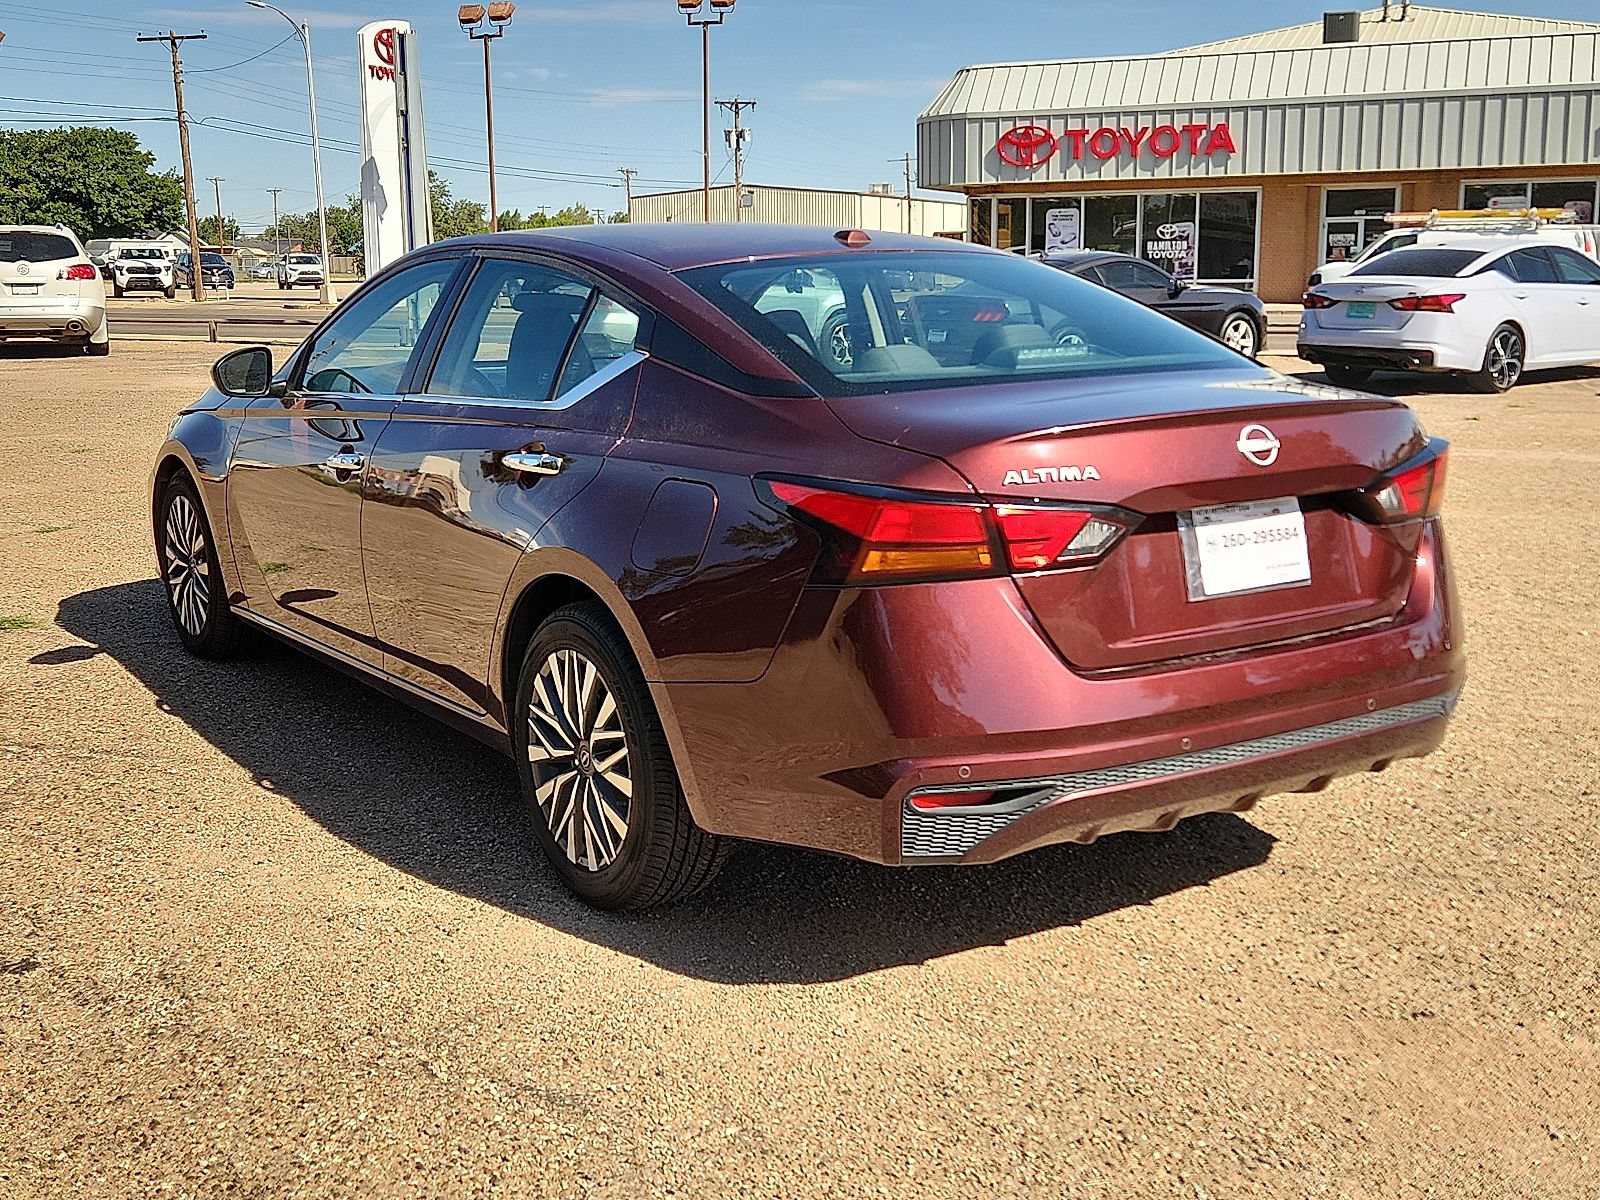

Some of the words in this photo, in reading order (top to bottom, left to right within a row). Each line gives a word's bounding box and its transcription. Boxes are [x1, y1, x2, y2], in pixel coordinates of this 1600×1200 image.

[1065, 123, 1237, 160] TOYOTA
[1147, 241, 1188, 251] HAMILTON
[1147, 251, 1187, 259] TOYOTA
[1002, 465, 1101, 486] ALTIMA
